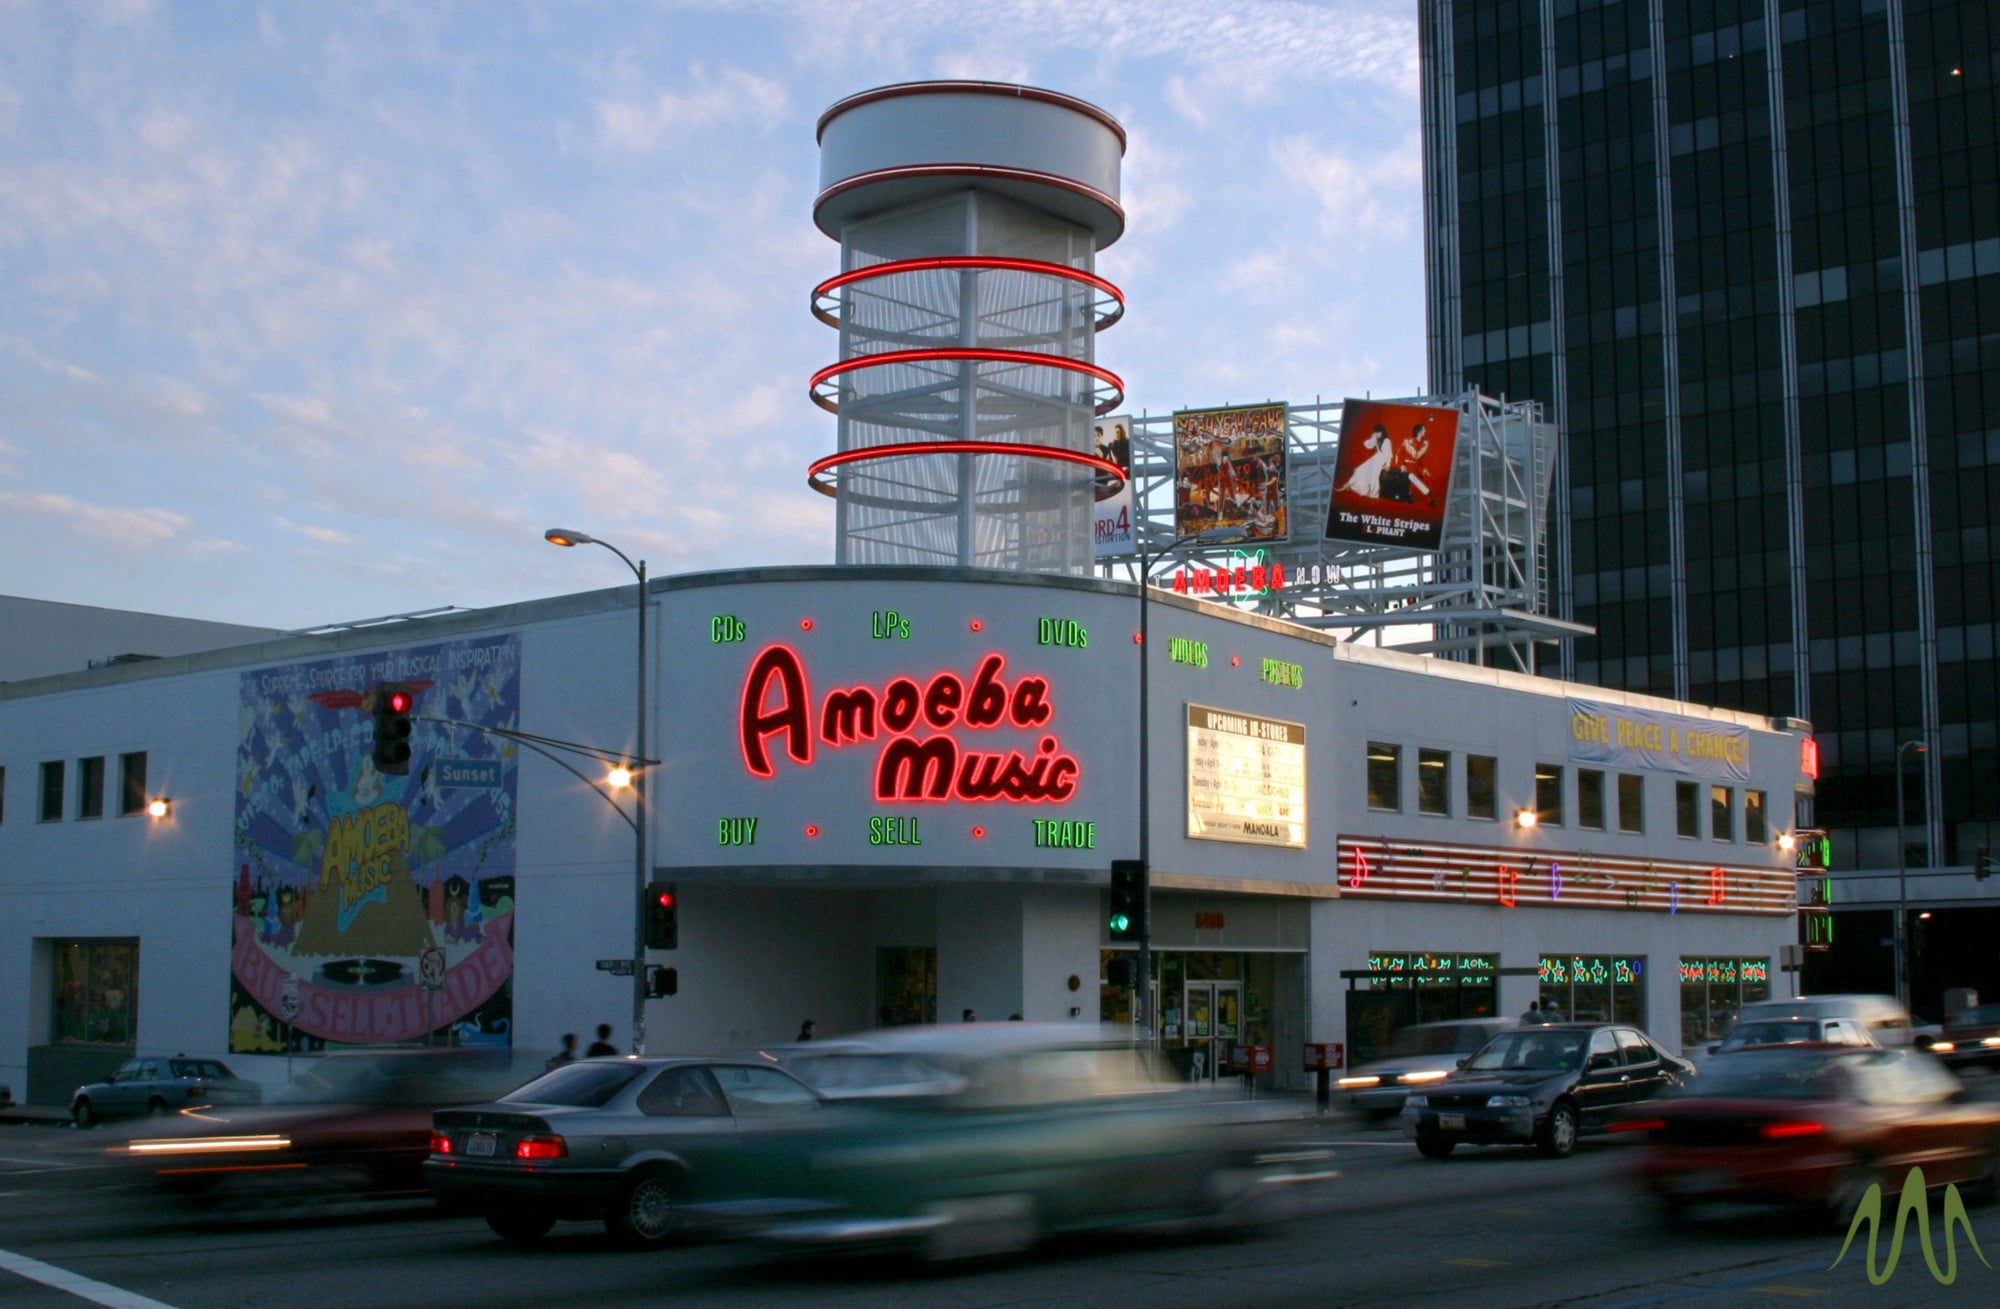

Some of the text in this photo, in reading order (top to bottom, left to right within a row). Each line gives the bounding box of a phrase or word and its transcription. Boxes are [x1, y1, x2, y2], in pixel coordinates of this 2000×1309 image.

[1177, 416, 1214, 432] YEAH
[1216, 414, 1245, 432] YEAH
[1115, 505, 1131, 534] 4
[1340, 512, 1430, 532] The White Stripes
[1172, 563, 1285, 595] AMOEBA
[1295, 565, 1341, 585] NOW
[711, 611, 1303, 690] CDs LPs DVDs VIDEOS POSTERS
[740, 643, 1052, 778] Amoeba
[1206, 712, 1247, 735] UPCOMING
[1572, 713, 1610, 744] GIVE
[1616, 717, 1663, 752] PEACE
[1670, 727, 1680, 753] A
[443, 764, 495, 782] Sunset
[875, 734, 1081, 803] Music
[320, 801, 411, 892] AMOEBA
[719, 816, 1096, 850] BUY SELL TRADE
[343, 853, 393, 912] MUSIC
[307, 991, 385, 1038] SELL
